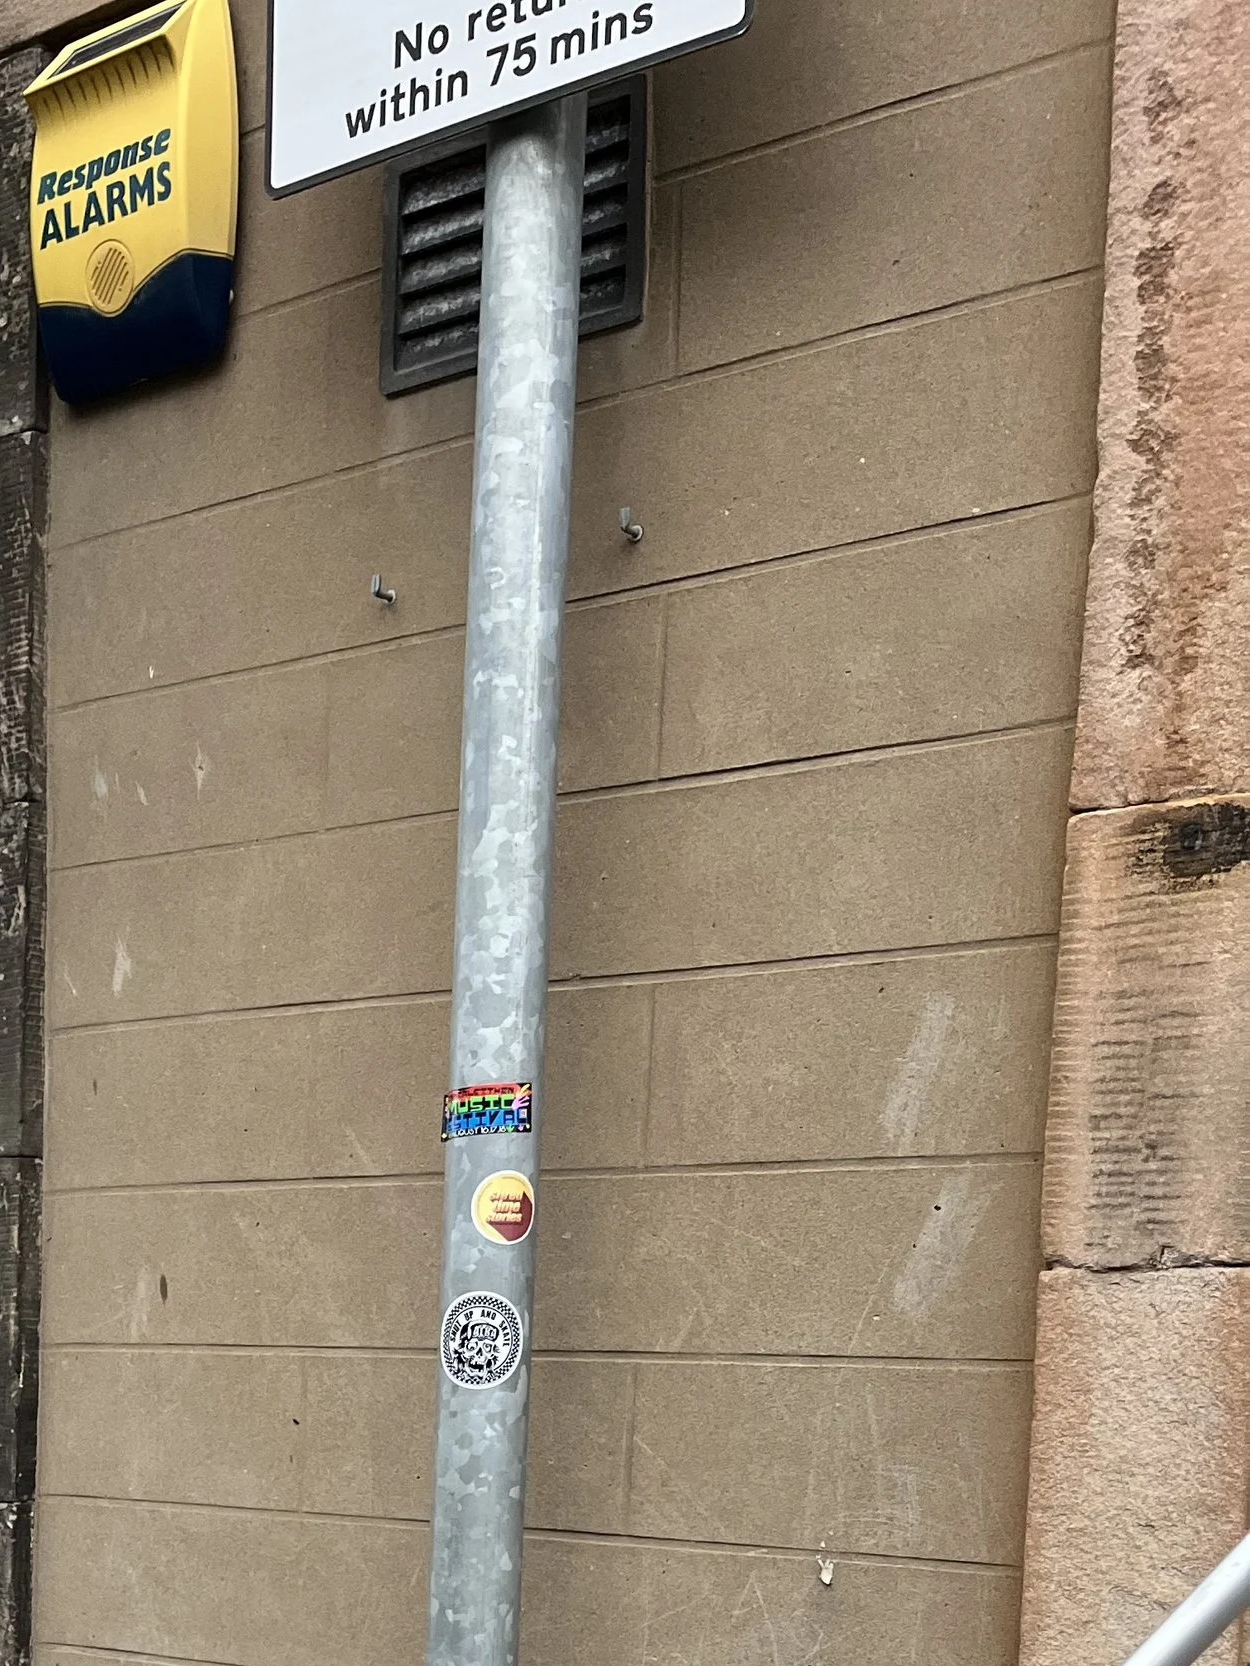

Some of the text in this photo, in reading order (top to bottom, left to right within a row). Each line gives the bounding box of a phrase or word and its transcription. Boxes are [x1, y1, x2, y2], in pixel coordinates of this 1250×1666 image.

[345, 2, 653, 138] within 75 mins
[394, 0, 566, 68] No retu
[37, 128, 171, 205] Response
[40, 161, 172, 250] ALARMS
[449, 1094, 515, 1115] MUSIC
[480, 1309, 497, 1320] AND
